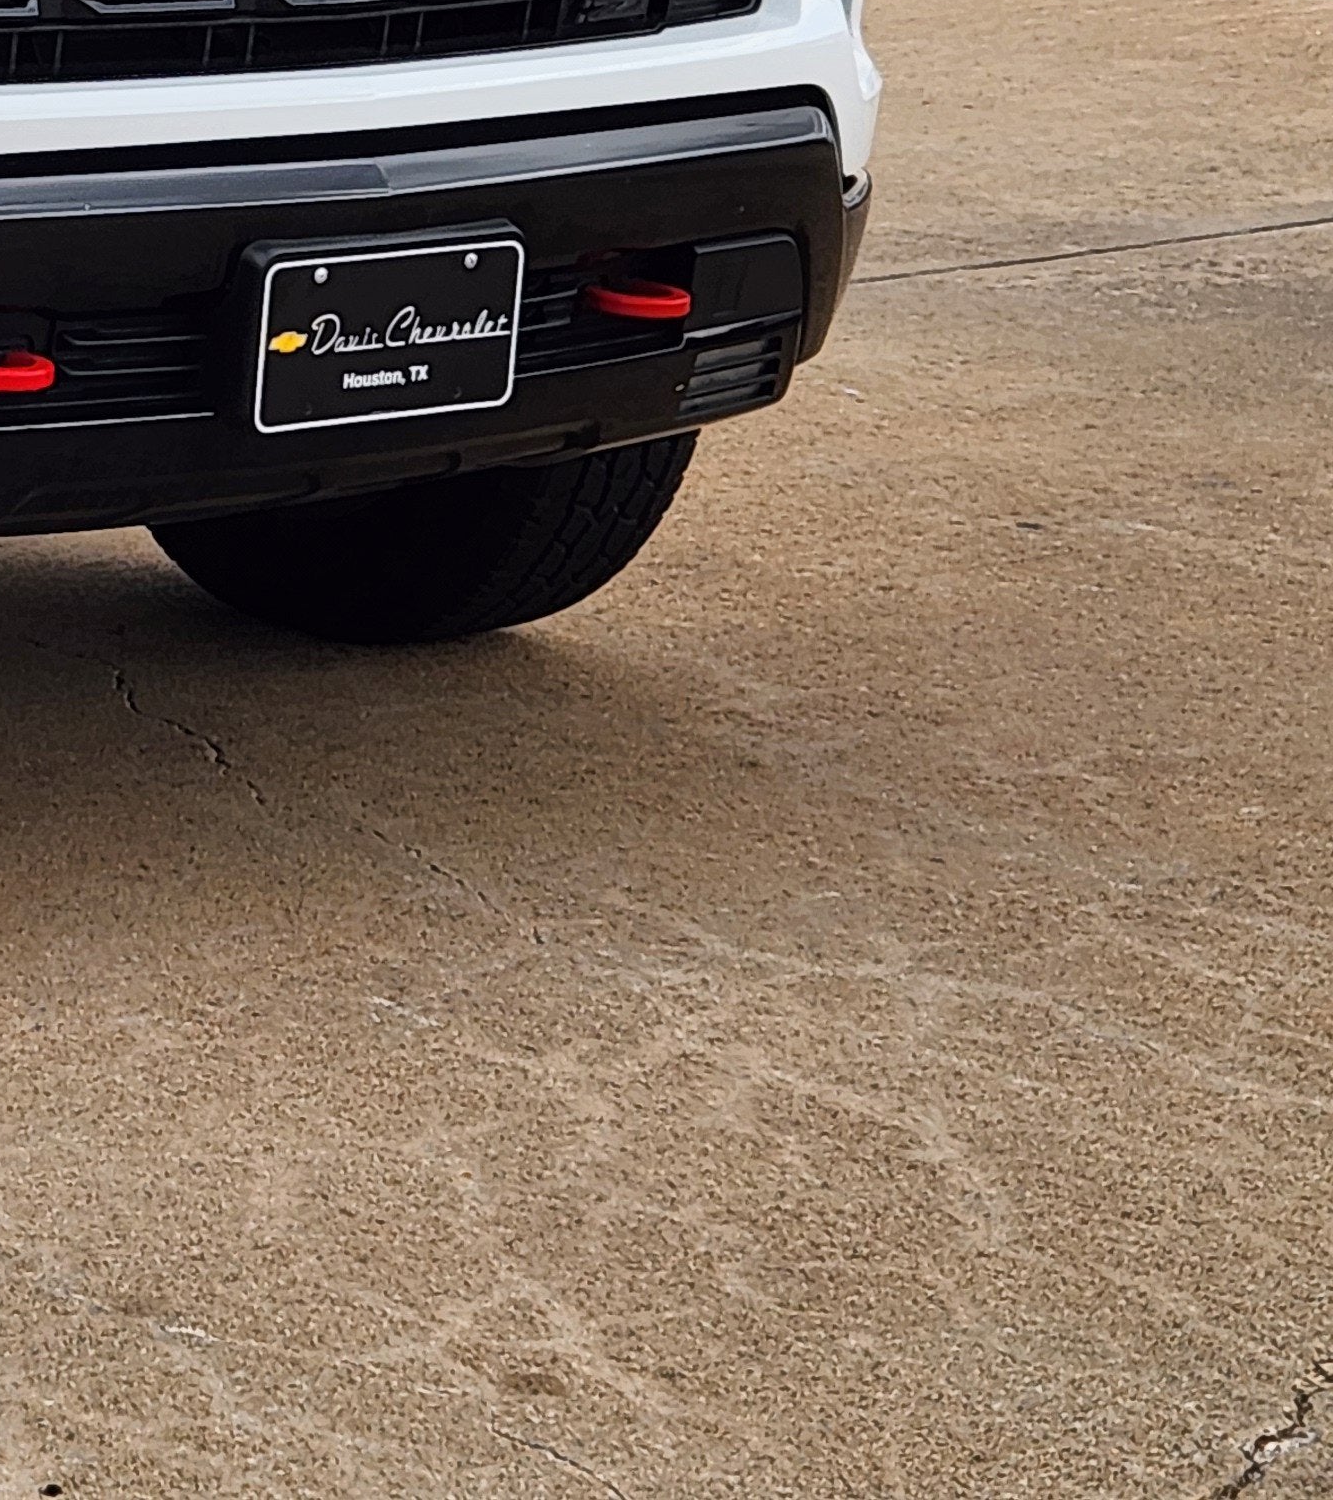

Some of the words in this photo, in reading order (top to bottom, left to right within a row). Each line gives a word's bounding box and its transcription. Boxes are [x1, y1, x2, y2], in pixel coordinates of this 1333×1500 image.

[311, 313, 383, 355] Davis
[385, 306, 510, 347] Chevrolet
[343, 368, 406, 389] Houston,
[409, 365, 429, 380] TX
